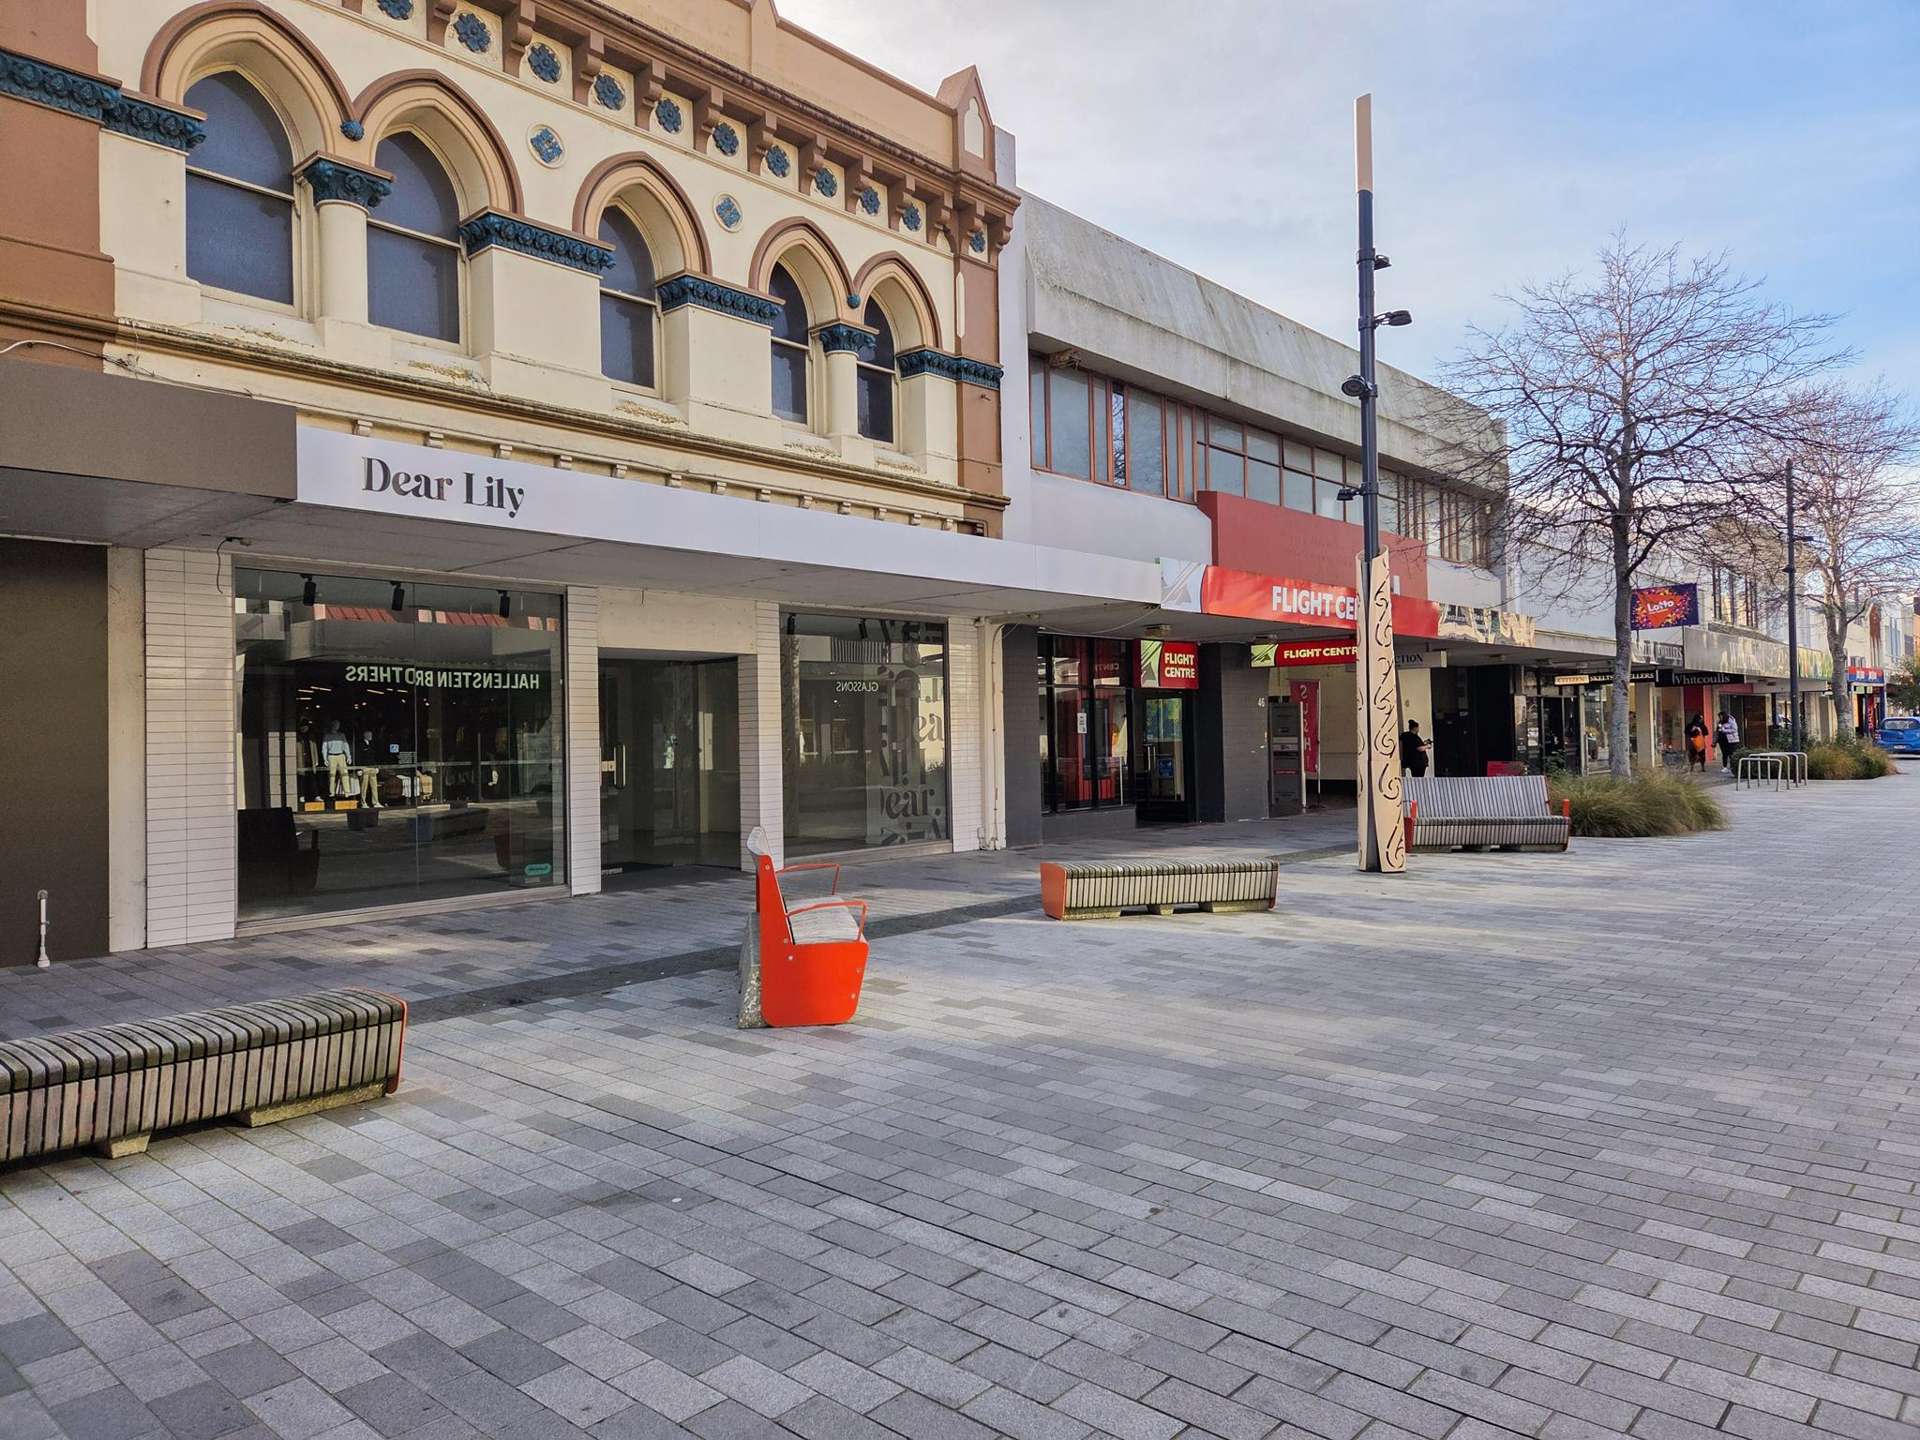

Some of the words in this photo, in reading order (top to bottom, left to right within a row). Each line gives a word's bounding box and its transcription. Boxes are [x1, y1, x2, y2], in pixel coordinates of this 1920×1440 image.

[362, 456, 453, 501] Dear
[463, 471, 525, 519] Lily
[1272, 585, 1333, 617] FLIGHT
[1164, 652, 1195, 665] FLIGHT
[1284, 648, 1322, 659] FLIGHT
[1164, 666, 1196, 679] CENTRE
[1672, 672, 1731, 685] Whitcoulls
